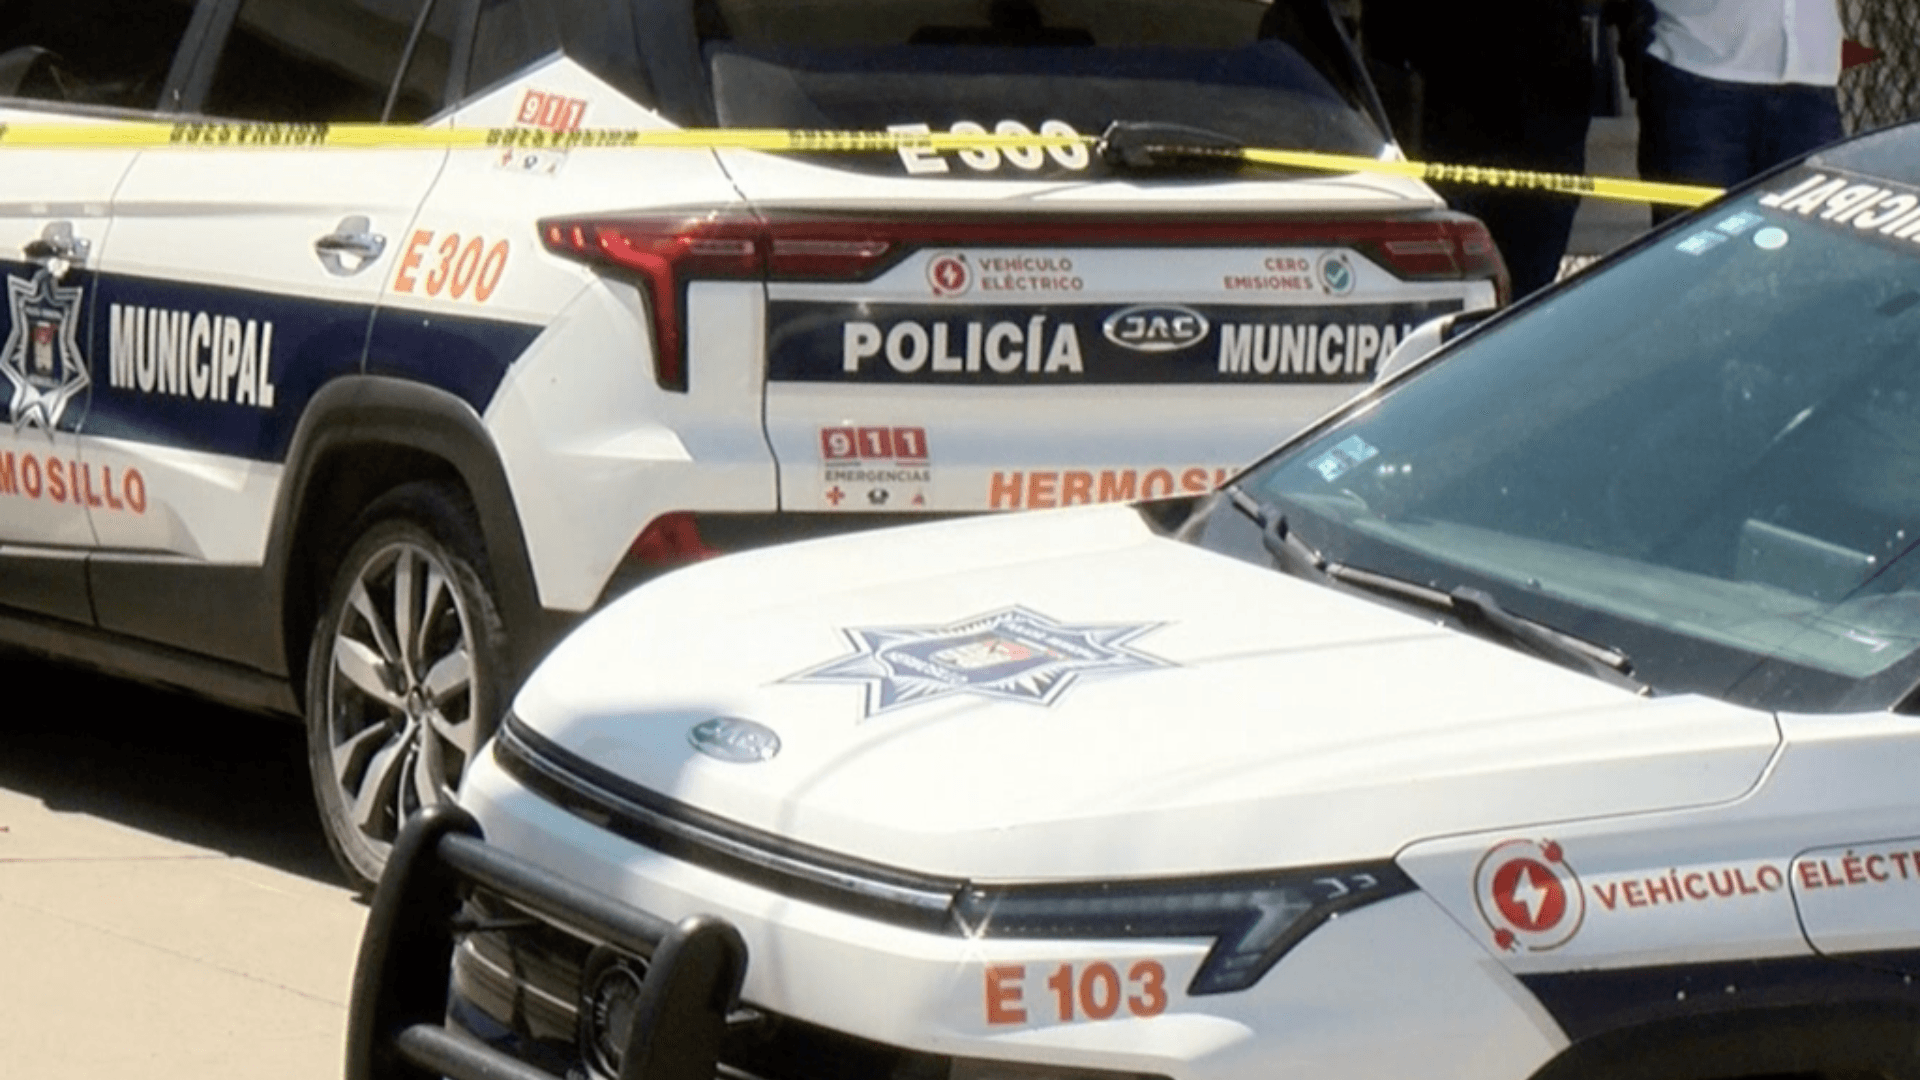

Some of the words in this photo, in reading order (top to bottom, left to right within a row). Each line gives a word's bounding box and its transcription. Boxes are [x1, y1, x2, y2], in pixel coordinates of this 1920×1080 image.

[887, 123, 949, 173] E
[394, 230, 434, 292] E
[426, 233, 509, 302] 300
[979, 254, 1073, 271] VEHÍCULO
[1264, 257, 1310, 271] CERO
[981, 273, 1084, 290] ELÉCTRICO
[1223, 275, 1314, 290] EMISIONES
[110, 303, 274, 407] MUNICIPAL
[843, 315, 1084, 373] POLICÍA
[828, 431, 918, 455] 911
[825, 470, 930, 482] EMERGENCIAS
[1593, 867, 1784, 911] VEHÍCULO
[984, 965, 1026, 1025] E
[1048, 960, 1167, 1020] 103
